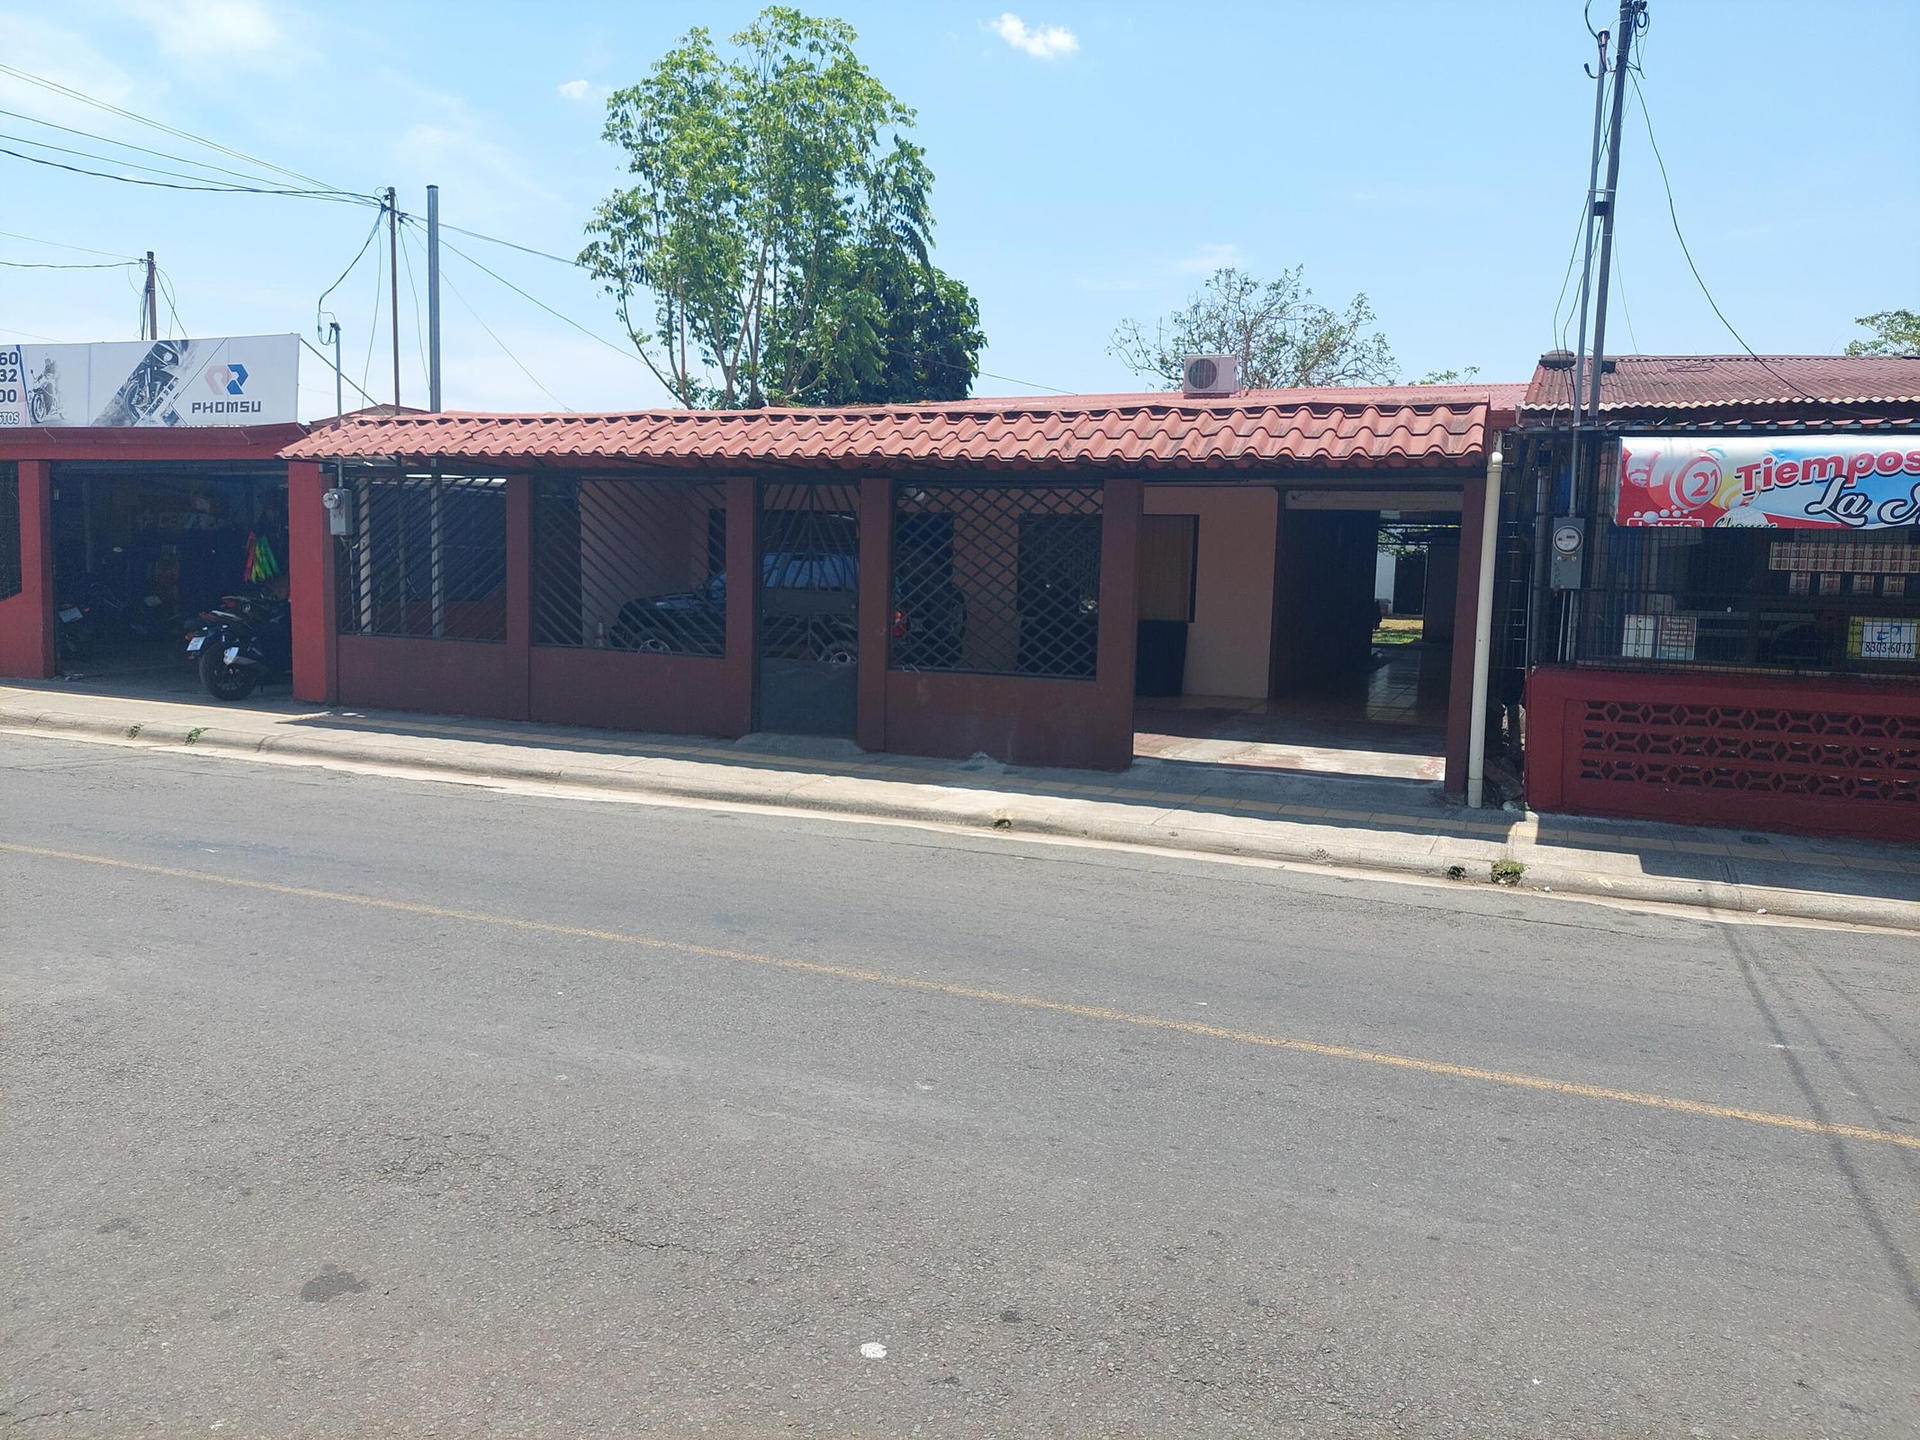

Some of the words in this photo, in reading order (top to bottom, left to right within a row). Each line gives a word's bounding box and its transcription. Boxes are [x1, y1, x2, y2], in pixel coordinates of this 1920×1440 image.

[0, 369, 17, 382] 32
[192, 401, 261, 414] PHOMSU
[1736, 449, 1920, 493] Tiempos
[1804, 475, 1873, 528] La
